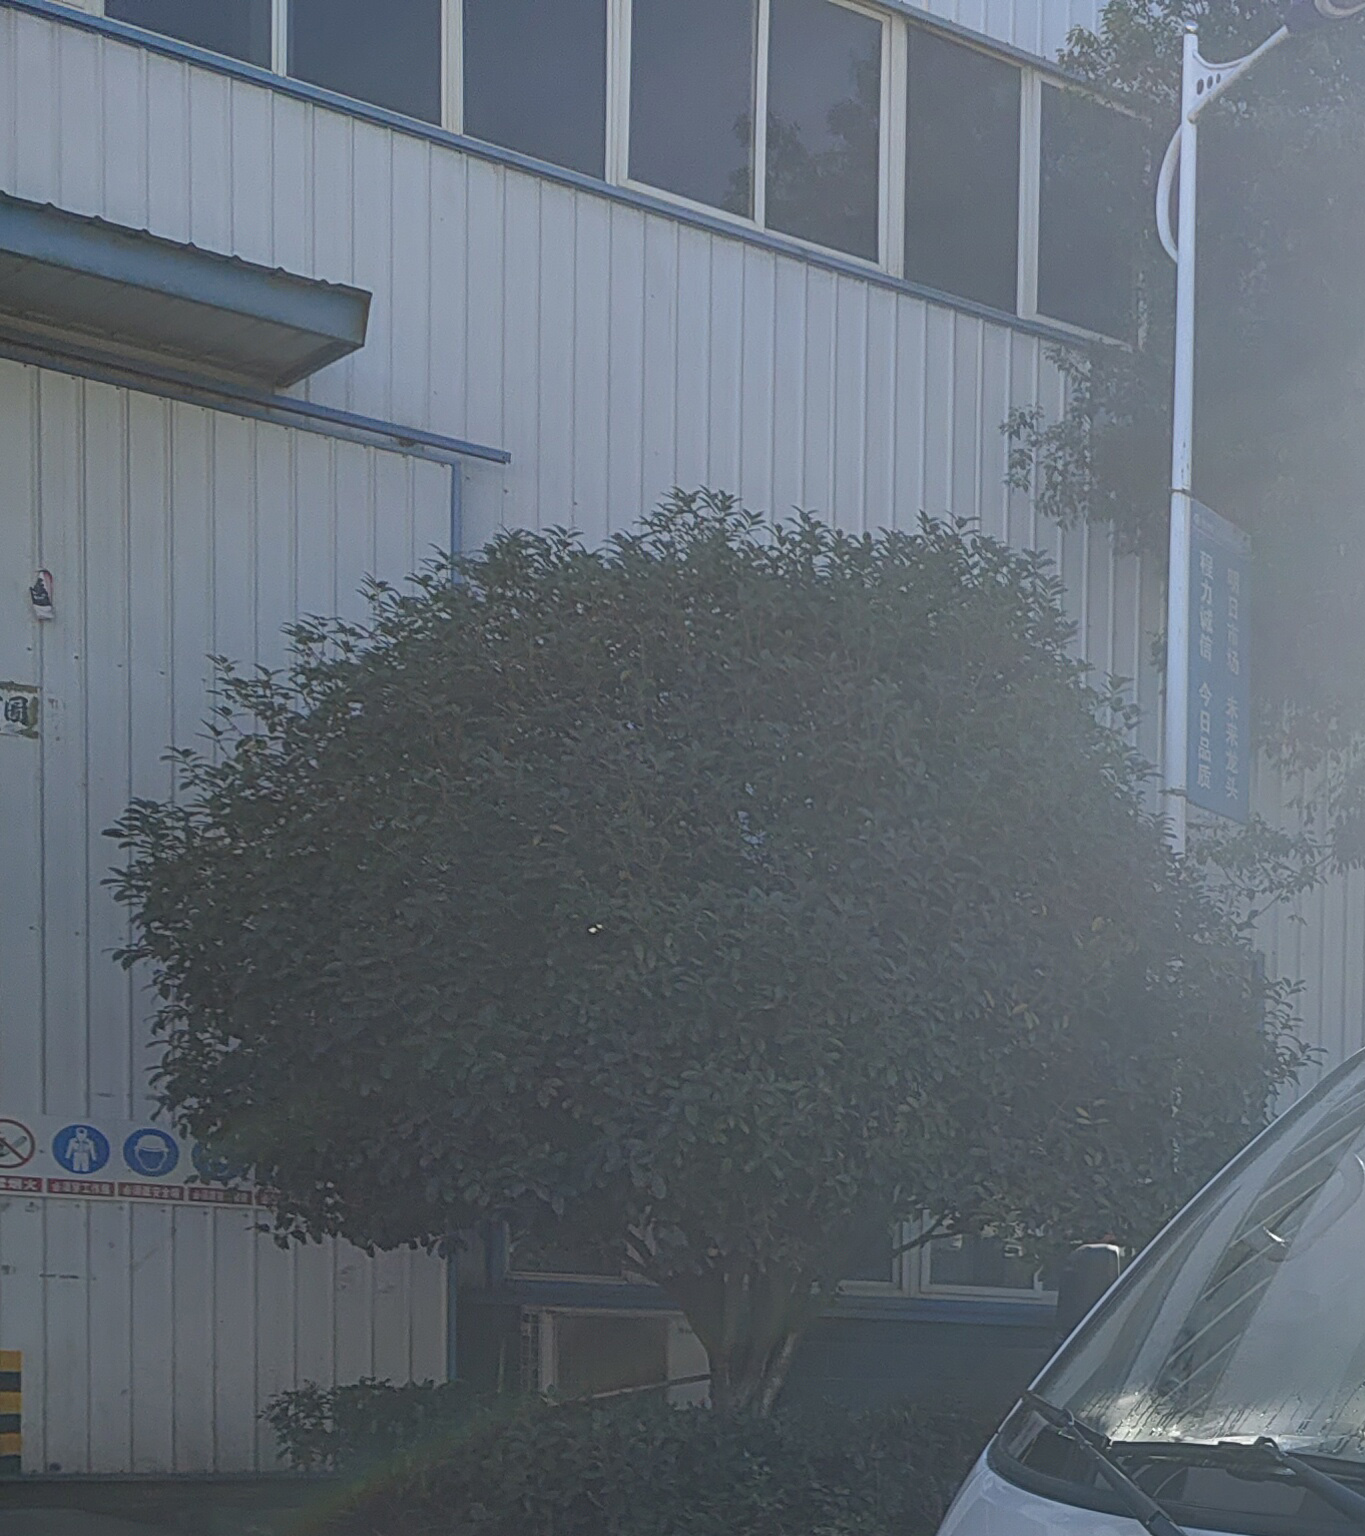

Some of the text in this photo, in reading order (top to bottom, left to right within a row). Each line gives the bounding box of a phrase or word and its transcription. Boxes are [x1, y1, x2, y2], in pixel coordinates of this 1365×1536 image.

[1197, 681, 1212, 790] 今日品质
[1225, 695, 1239, 800] 未来龙头
